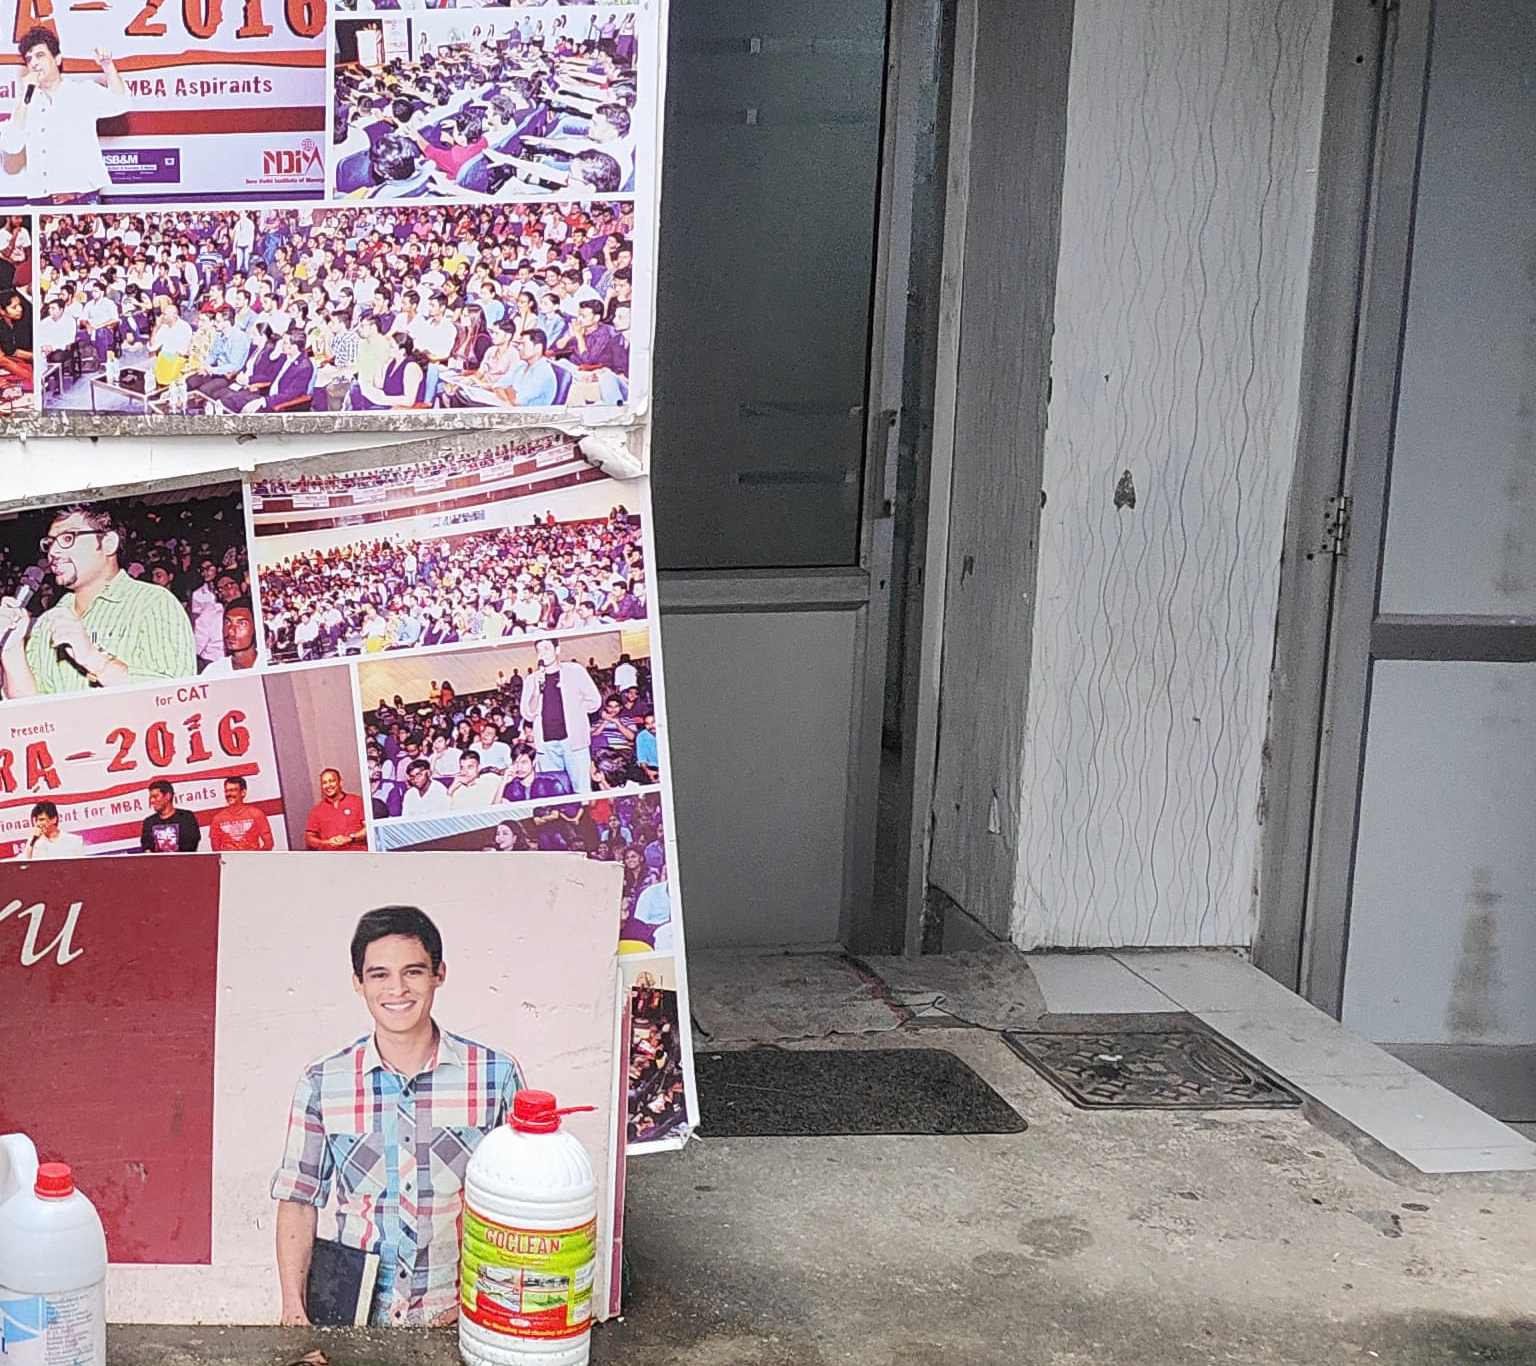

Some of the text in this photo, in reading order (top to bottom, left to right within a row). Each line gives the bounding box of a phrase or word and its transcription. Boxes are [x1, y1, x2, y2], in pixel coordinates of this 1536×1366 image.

[175, 76, 273, 97] Aspirants
[155, 684, 210, 707] for CAT
[10, 721, 56, 739] Presents
[84, 805, 106, 819] for
[110, 798, 143, 817] MBA
